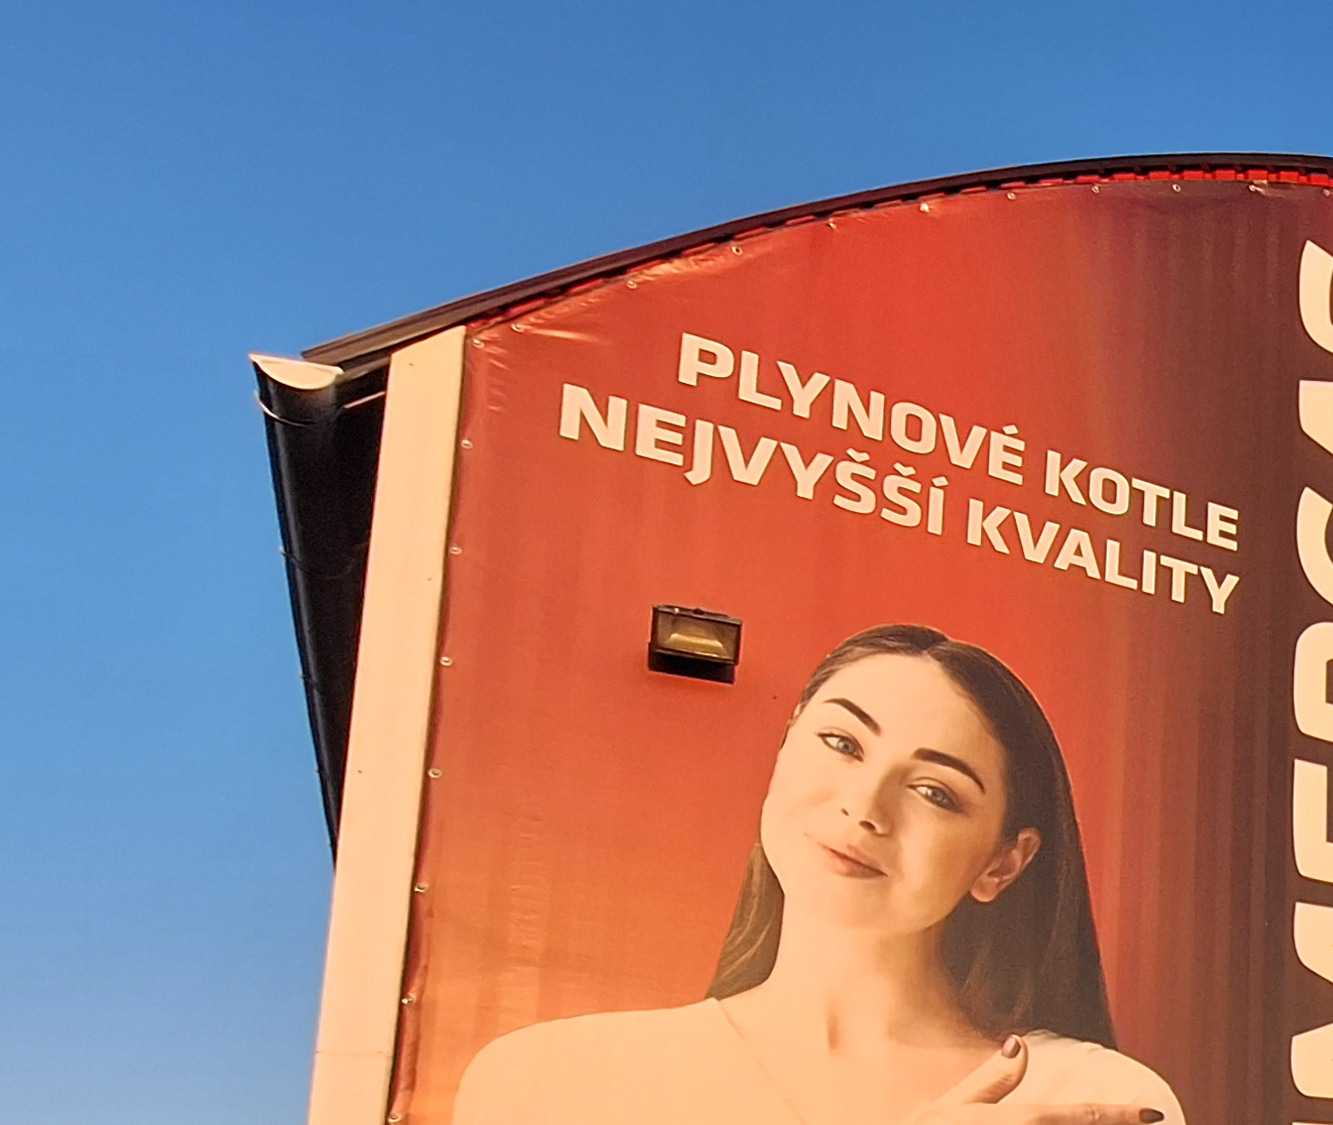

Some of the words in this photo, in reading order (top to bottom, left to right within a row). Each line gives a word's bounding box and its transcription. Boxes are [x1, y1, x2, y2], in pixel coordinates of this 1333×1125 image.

[558, 382, 950, 536] NEJVYŠŠÍ
[966, 498, 1240, 615] KVALITY
[678, 332, 1025, 486] PLYNOVÉ
[1044, 450, 1240, 552] KOTLE
